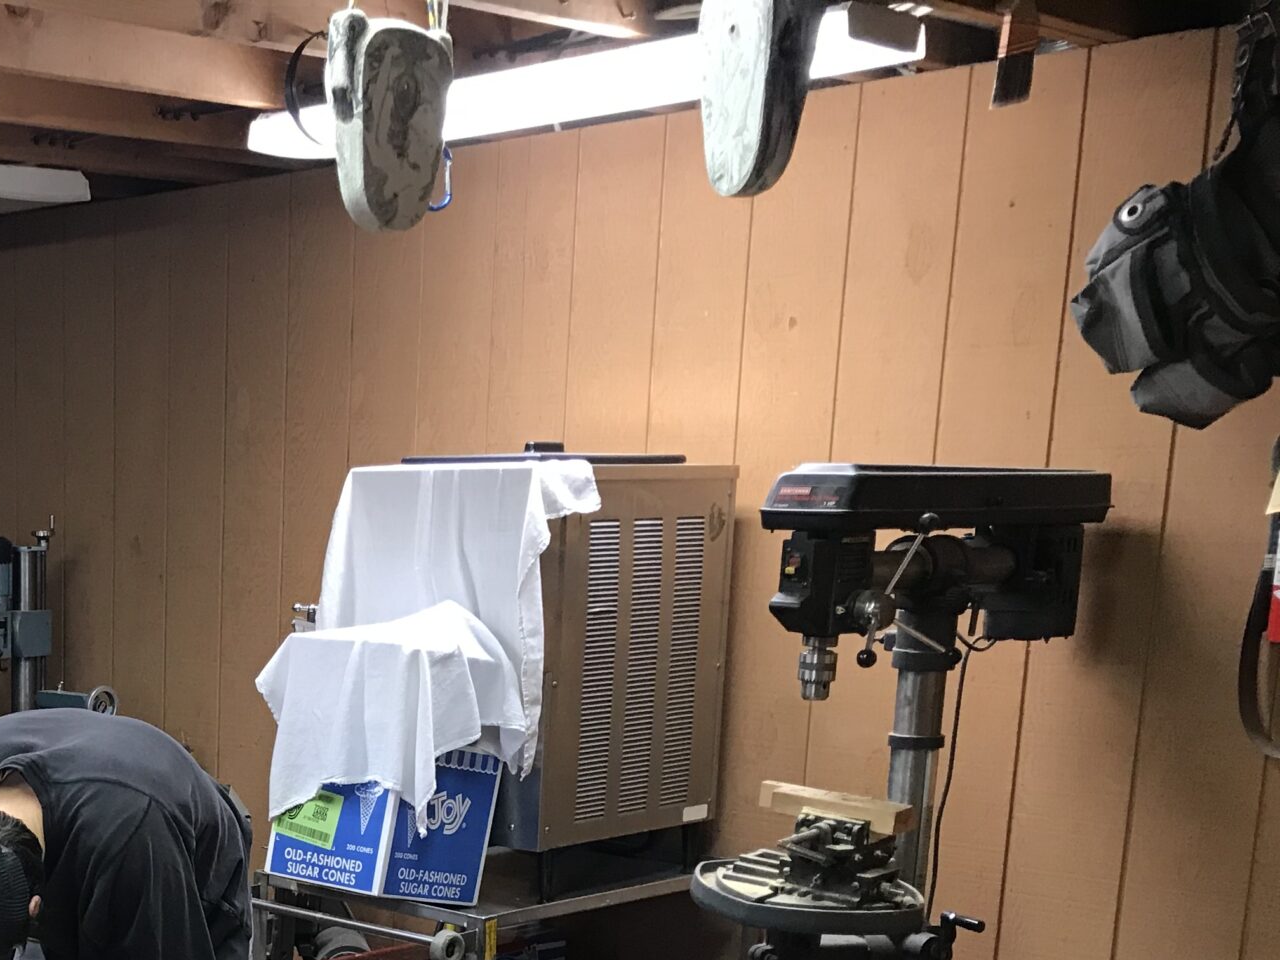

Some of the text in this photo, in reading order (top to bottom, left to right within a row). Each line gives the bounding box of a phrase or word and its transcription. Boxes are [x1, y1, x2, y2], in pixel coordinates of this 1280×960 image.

[427, 790, 472, 836] Joy
[284, 847, 363, 873] OLD-FASHIONED
[356, 844, 374, 854] CONES
[286, 861, 356, 886] SUGAR CONES
[398, 867, 468, 886] OLD-FASHIONED
[399, 881, 461, 899] SUGAR CONES
